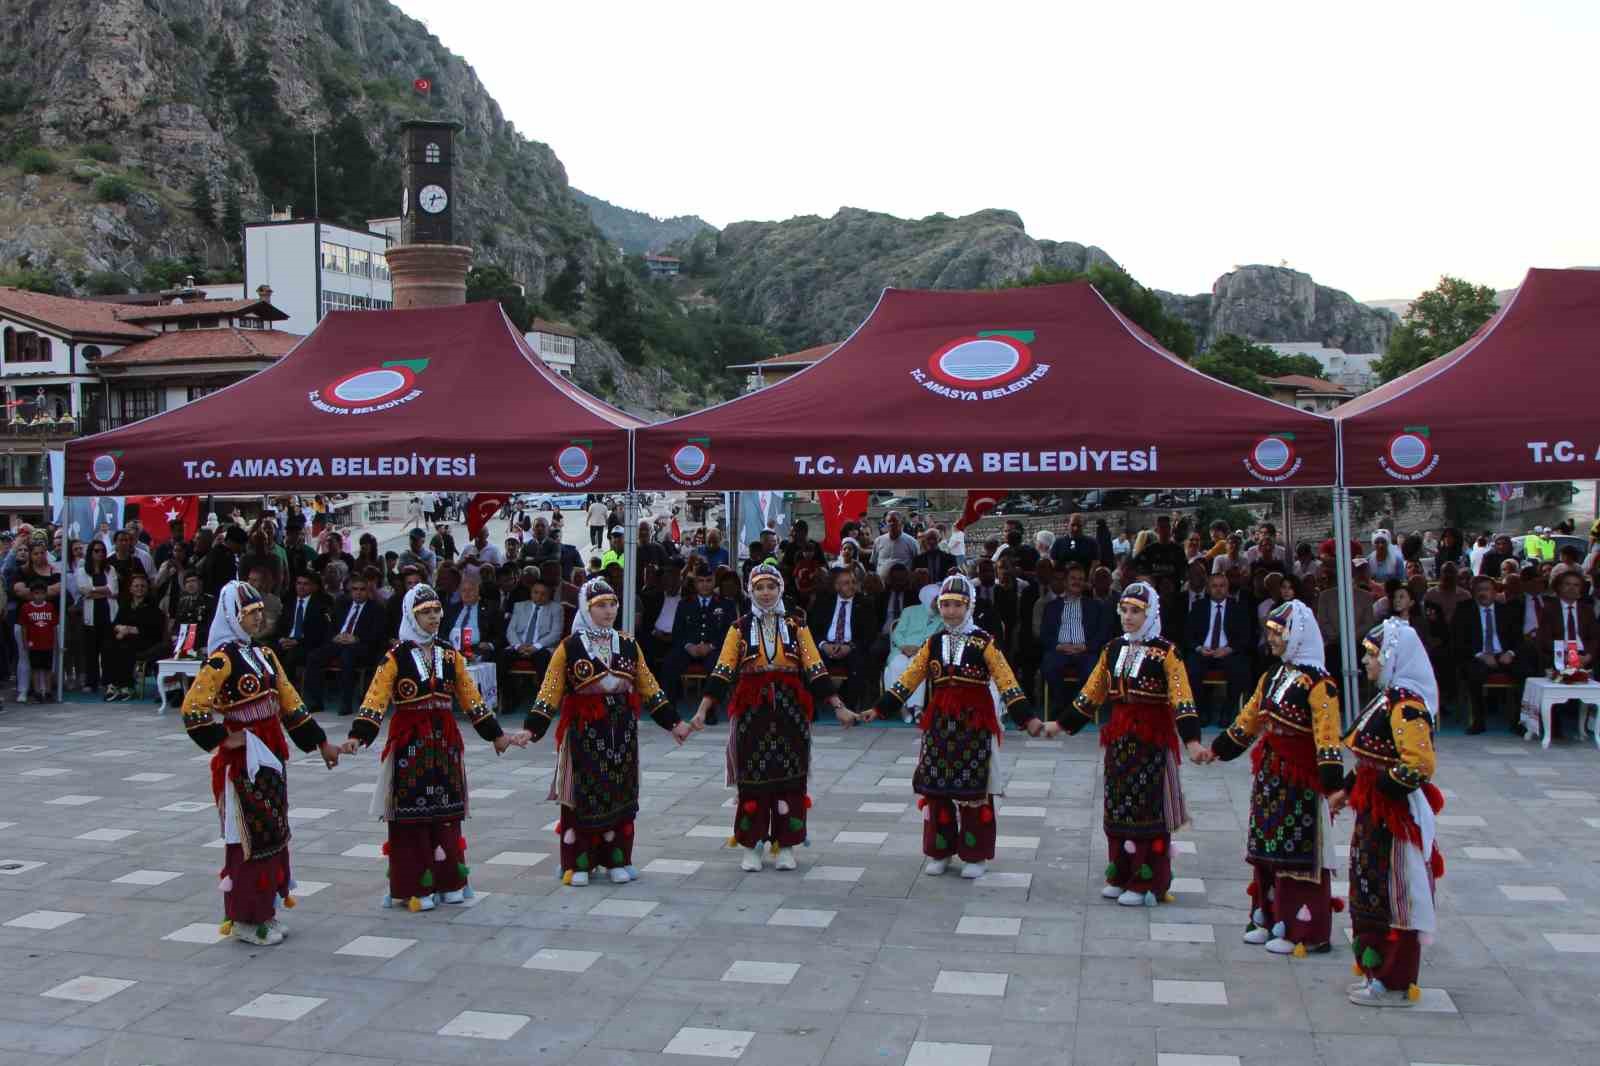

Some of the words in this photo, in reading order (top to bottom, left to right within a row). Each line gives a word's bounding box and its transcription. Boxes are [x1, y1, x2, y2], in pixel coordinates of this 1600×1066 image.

[923, 381, 978, 400] AMASYA
[795, 456, 844, 475] T.C.
[852, 453, 973, 474] AMASYA
[982, 446, 1158, 474] BELEDİYESİ
[1527, 440, 1585, 463] T.C.
[184, 461, 222, 479] T.C.
[229, 458, 324, 478] AMASYA
[331, 453, 476, 477] BELEDİYESİ
